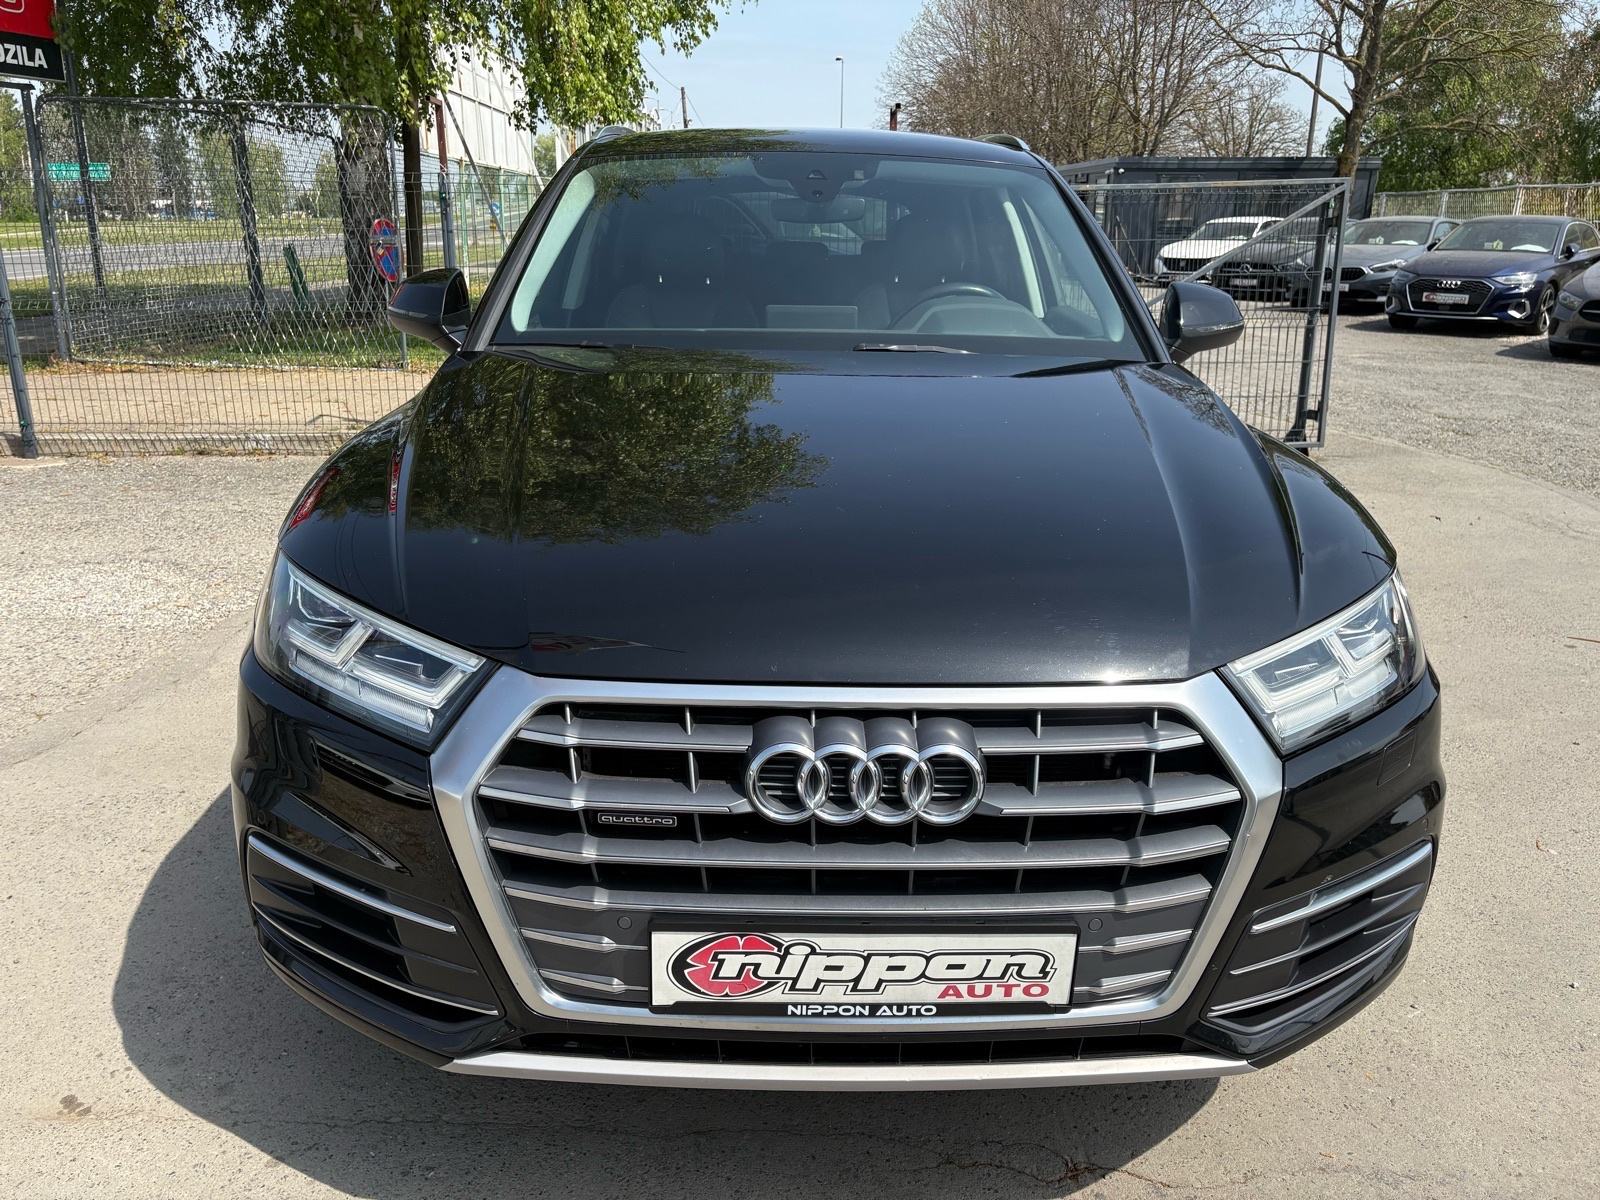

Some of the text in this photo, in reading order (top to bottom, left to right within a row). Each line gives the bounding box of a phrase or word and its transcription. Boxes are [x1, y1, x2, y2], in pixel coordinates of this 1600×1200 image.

[601, 816, 673, 824] quattro
[708, 939, 1058, 995] nippon
[936, 983, 1051, 999] AUTO
[787, 1004, 938, 1016] NIPPON AUTO
